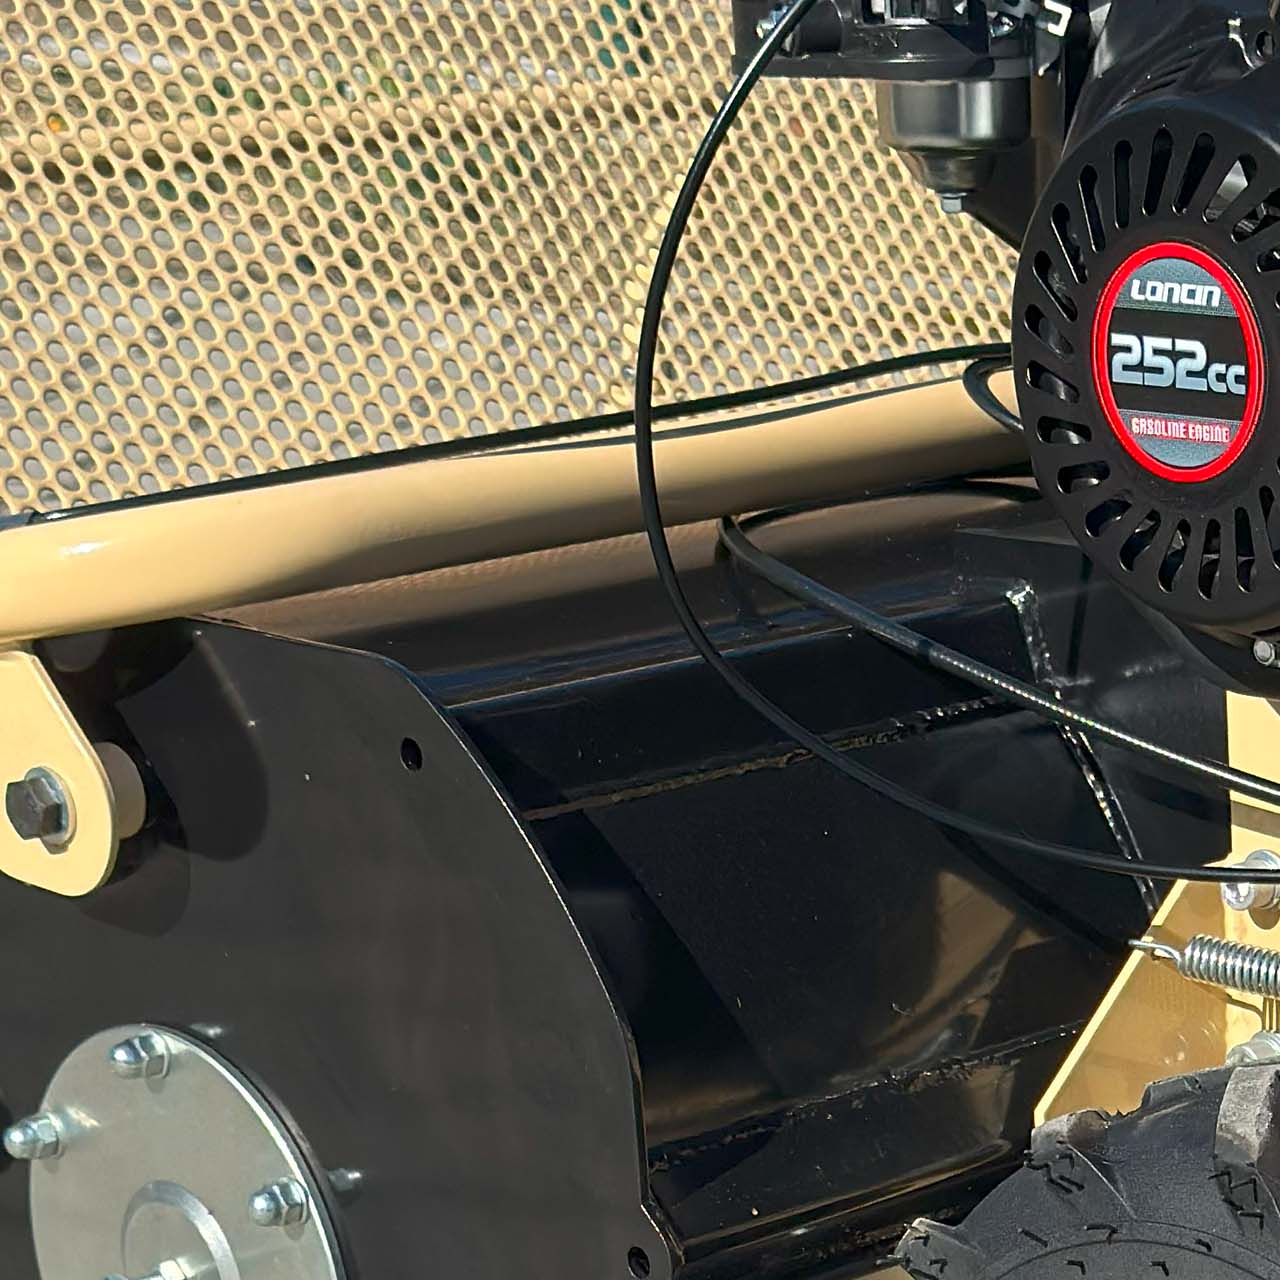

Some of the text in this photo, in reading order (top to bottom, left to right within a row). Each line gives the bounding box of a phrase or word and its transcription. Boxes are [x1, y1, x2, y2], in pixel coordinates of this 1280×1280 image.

[1110, 332, 1246, 395] 252cc
[1131, 417, 1230, 443] GASOLINE ENGINE
